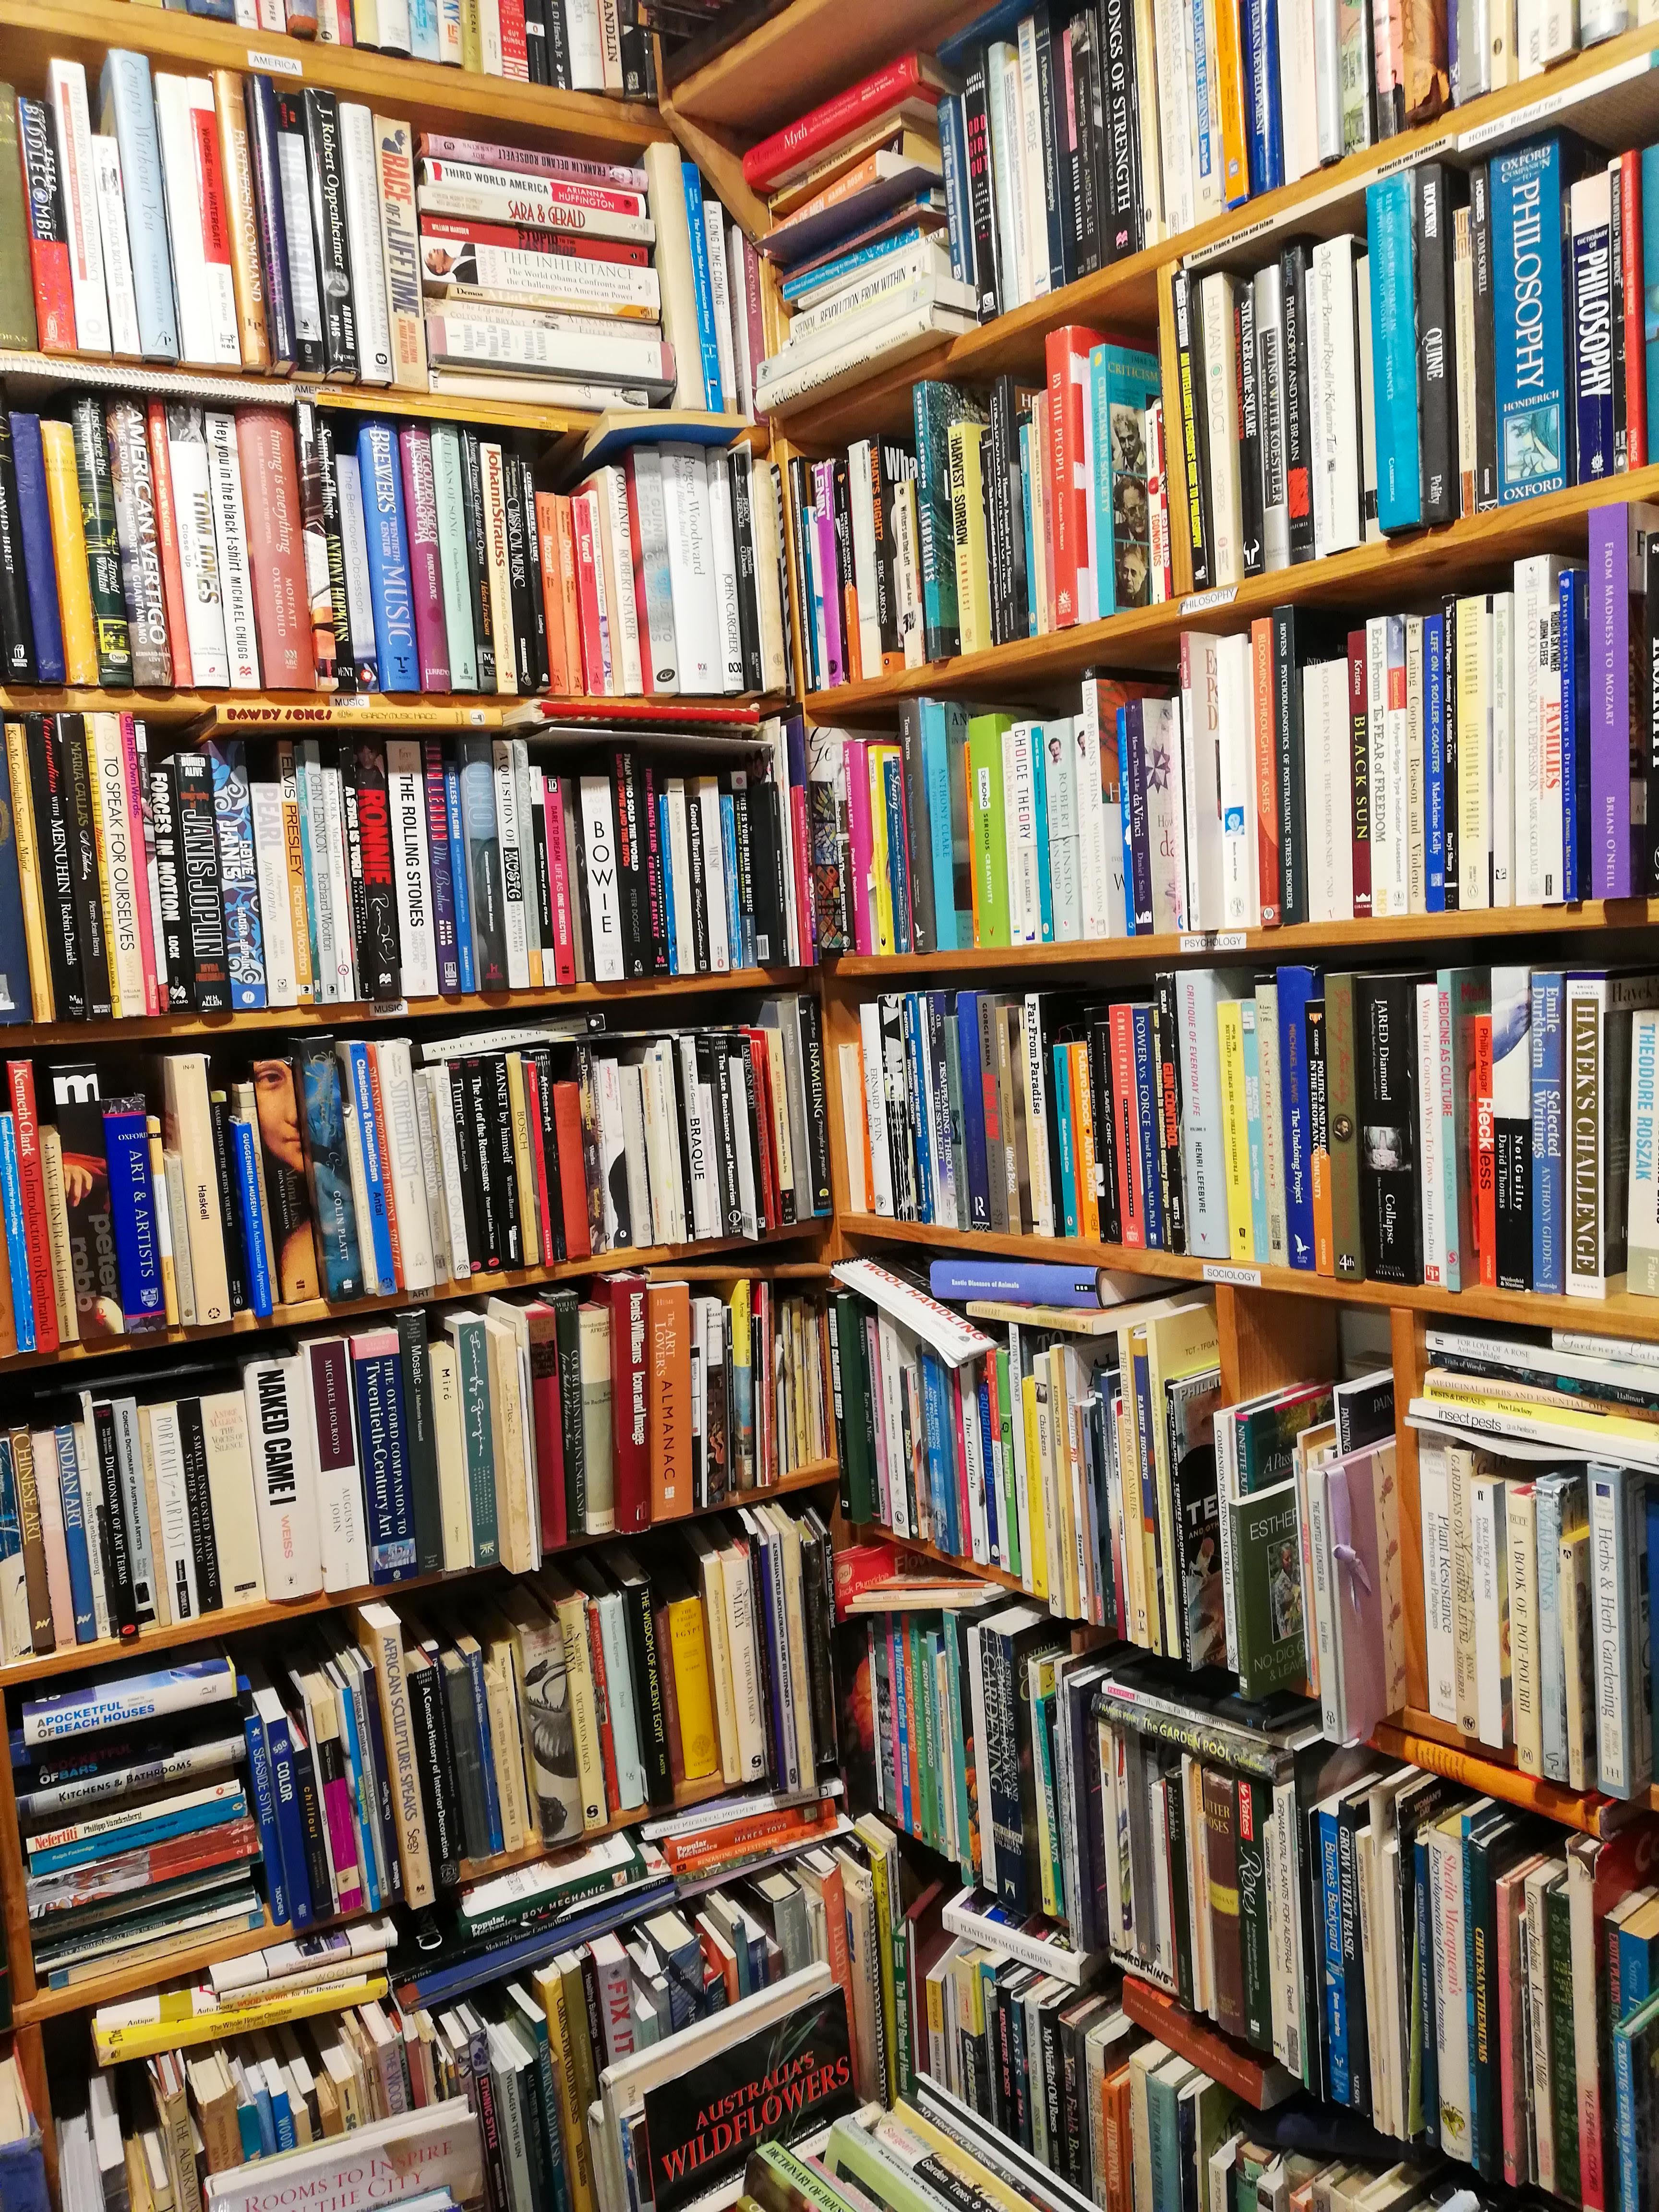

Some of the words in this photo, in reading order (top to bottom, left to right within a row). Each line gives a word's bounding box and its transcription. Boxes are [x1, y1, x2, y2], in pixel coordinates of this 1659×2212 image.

[1109, 0, 1121, 66] ONGS
[253, 55, 298, 71] AMERICA
[1111, 72, 1125, 89] OF
[320, 126, 335, 173] Robert
[1112, 93, 1130, 212] STRENGTH
[1501, 147, 1551, 171] OXFORD
[201, 127, 212, 162] WORSE
[209, 192, 222, 250] WATERGATE
[383, 152, 411, 204] RACE
[444, 167, 472, 181] THIRD
[473, 172, 506, 186] WORLD
[509, 178, 548, 194] AMERICA
[325, 175, 344, 269] Oppenheimer
[386, 204, 401, 219] OF
[386, 218, 402, 229] A
[509, 200, 534, 221] SARA
[537, 207, 545, 223] &
[548, 204, 585, 228] GERALD
[1577, 230, 1608, 246] DICTIONARY
[386, 228, 420, 318] LIFETIME
[501, 252, 531, 267] THE
[537, 254, 634, 280] INHERITANCE
[1513, 178, 1544, 390] PHILOSOPHY
[820, 289, 859, 323] REVOLUTION
[861, 277, 880, 302] FROM
[881, 266, 906, 294] WITHIN
[330, 314, 339, 337] PAIS
[342, 304, 354, 349] ABRAHAM
[1578, 247, 1611, 398] PHILOSOPHY
[1504, 391, 1559, 412] HONDERICH
[214, 421, 229, 449] Hey,
[218, 450, 229, 466] you
[220, 469, 228, 478] in
[683, 455, 696, 496] Roger
[870, 446, 881, 503] WHAT'S
[221, 481, 232, 499] the
[1504, 478, 1563, 502] OXFORD
[128, 406, 155, 521] AMERICAN
[142, 541, 166, 644] VERTIGO
[192, 491, 211, 538] TOM
[223, 504, 236, 533] black
[872, 504, 884, 540] RIGHT?
[227, 535, 240, 571] t-shirt
[346, 493, 359, 551] Beethoven
[353, 556, 364, 615] Obsession
[687, 499, 705, 576] Woodward
[195, 539, 219, 604] JONES
[1604, 541, 1613, 579] FROM
[230, 576, 244, 622] MICHAEL
[383, 566, 412, 646] MUSIC
[722, 573, 733, 601] JOHN
[1180, 589, 1234, 608] PHILOSOPHY
[724, 603, 739, 654] CARGHER
[1605, 584, 1614, 645] MADNESS
[235, 626, 248, 660] CHUGG
[1605, 651, 1613, 668] TO
[335, 698, 364, 707] MUSIC
[1605, 673, 1614, 726] MOZART
[1014, 729, 1026, 781] CHOICE
[1354, 716, 1366, 789] BLACK
[1546, 702, 1561, 790] FAMILIES
[103, 757, 118, 782] TO
[281, 756, 294, 800] ELVIS
[400, 774, 414, 801] THE
[106, 784, 121, 829] SPEAK
[151, 772, 170, 835] FORCES
[1016, 787, 1030, 839] THEORY
[1356, 796, 1367, 840] SUN
[1606, 796, 1615, 836] BRIAN
[110, 833, 125, 863] FOR
[158, 840, 174, 856] IN
[182, 809, 214, 881] JANIS
[285, 802, 301, 875] PRESLEY
[360, 789, 391, 885] RONNIE
[403, 805, 419, 868] ROLLING
[158, 861, 179, 921] MOTION
[406, 870, 423, 926] STONES
[592, 821, 613, 933] BOWIE
[113, 867, 134, 950] OURSELVES
[187, 885, 223, 957] JOPLIN
[293, 885, 304, 929] Richard
[168, 935, 178, 959] LOCK
[295, 932, 307, 975] Wootton
[1184, 937, 1241, 948] PSYCHOLOGY
[374, 1003, 403, 1013] MUSIC
[1374, 1000, 1388, 1043] JARED
[1378, 1049, 1392, 1102] Diamond
[1575, 1002, 1594, 1111] HAYEK'S
[13, 1068, 30, 1119] Kenneth
[19, 1120, 33, 1158] Clark
[517, 1111, 528, 1150] BOSCH
[690, 1118, 705, 1181] BRAQUE
[129, 1149, 144, 1187] ART
[1195, 1142, 1203, 1170] HENRI
[133, 1192, 142, 1202] &
[198, 1184, 210, 1220] Haskell
[333, 1190, 343, 1223] COLIN
[1197, 1171, 1206, 1214] LEFEBVRE
[1575, 1116, 1596, 1271] CHALLENGE
[134, 1210, 154, 1278] ARTISTS
[337, 1225, 349, 1261] PLATT
[412, 1289, 429, 1298] ART
[863, 1262, 903, 1293] WOOL
[905, 1287, 986, 1342] HANDLING
[257, 1370, 289, 1435] NAKED
[325, 1359, 337, 1403] MICHAEL
[328, 1407, 339, 1455] HOLROYD
[661, 1381, 677, 1479] ALMANAC
[1039, 1414, 1047, 1456] Chickens
[1438, 1407, 1469, 1426] insect
[1471, 1413, 1502, 1432] pests
[58, 1428, 77, 1488] INDIAN
[263, 1438, 292, 1495] CAME
[65, 1490, 83, 1529] ART
[1513, 1536, 1522, 1547] A
[1598, 1527, 1613, 1572] Herbs
[1515, 1550, 1524, 1589] BOOK
[1600, 1577, 1613, 1590] &
[1516, 1593, 1526, 1617] OF
[1601, 1594, 1613, 1635] Herb
[1516, 1623, 1531, 1715] POT-POURRI
[1602, 1639, 1615, 1719] Gardening
[1143, 1717, 1158, 1733] The
[1160, 1724, 1202, 1749] GARDEN
[59, 1780, 111, 1802] KITCHENS
[114, 1777, 122, 1787] &
[126, 1760, 192, 1784] BATHROOMS
[252, 1749, 270, 1793] SEASIDE
[261, 1794, 275, 1826] STYLE
[1240, 1798, 1250, 1836] Yates
[1323, 1840, 1337, 1889] Burke's
[1327, 1893, 1339, 1953] Backyard
[961, 1923, 983, 1940] PLANTS
[983, 1933, 997, 1946] FOR
[998, 1937, 1020, 1957] SMALL
[1020, 1950, 1052, 1968] GARDENS
[608, 1979, 628, 2022] FIX
[612, 2026, 633, 2054] IT
[696, 2051, 814, 2131] AUSTRALIA'S
[662, 2056, 850, 2183] WILDFLOWERS
